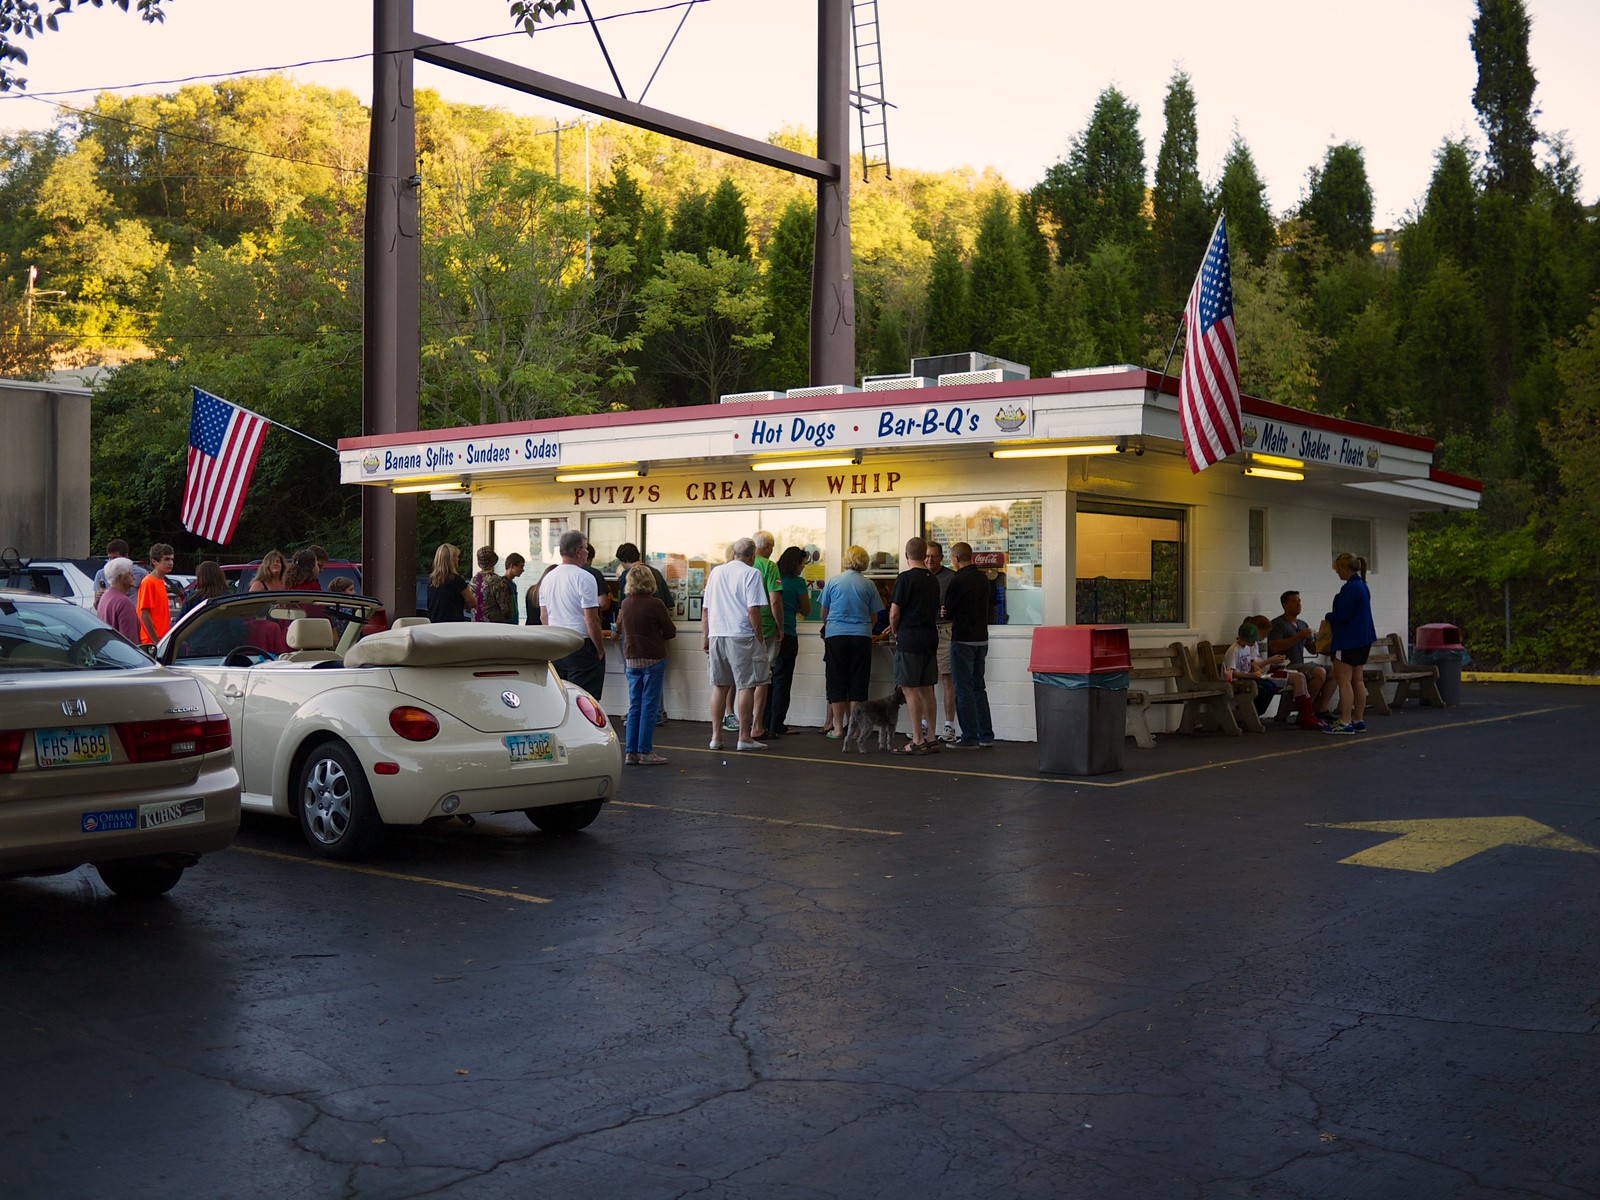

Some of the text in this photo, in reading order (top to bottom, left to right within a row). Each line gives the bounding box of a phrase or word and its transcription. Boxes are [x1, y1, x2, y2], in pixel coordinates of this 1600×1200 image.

[751, 407, 980, 447] Hot Dogs Bar-B-Q's
[384, 438, 557, 471] Banana Splits Sundaes Sodas
[1260, 423, 1365, 466] Malts Shakes Floats
[573, 472, 901, 505] PUTZ'S CREAMY WHIP
[42, 735, 106, 756] FHS 4589
[510, 740, 551, 756] FIZ 9302
[99, 813, 134, 823] OBAMA
[102, 820, 132, 829] BIDEN
[144, 804, 182, 827] KUHNS
